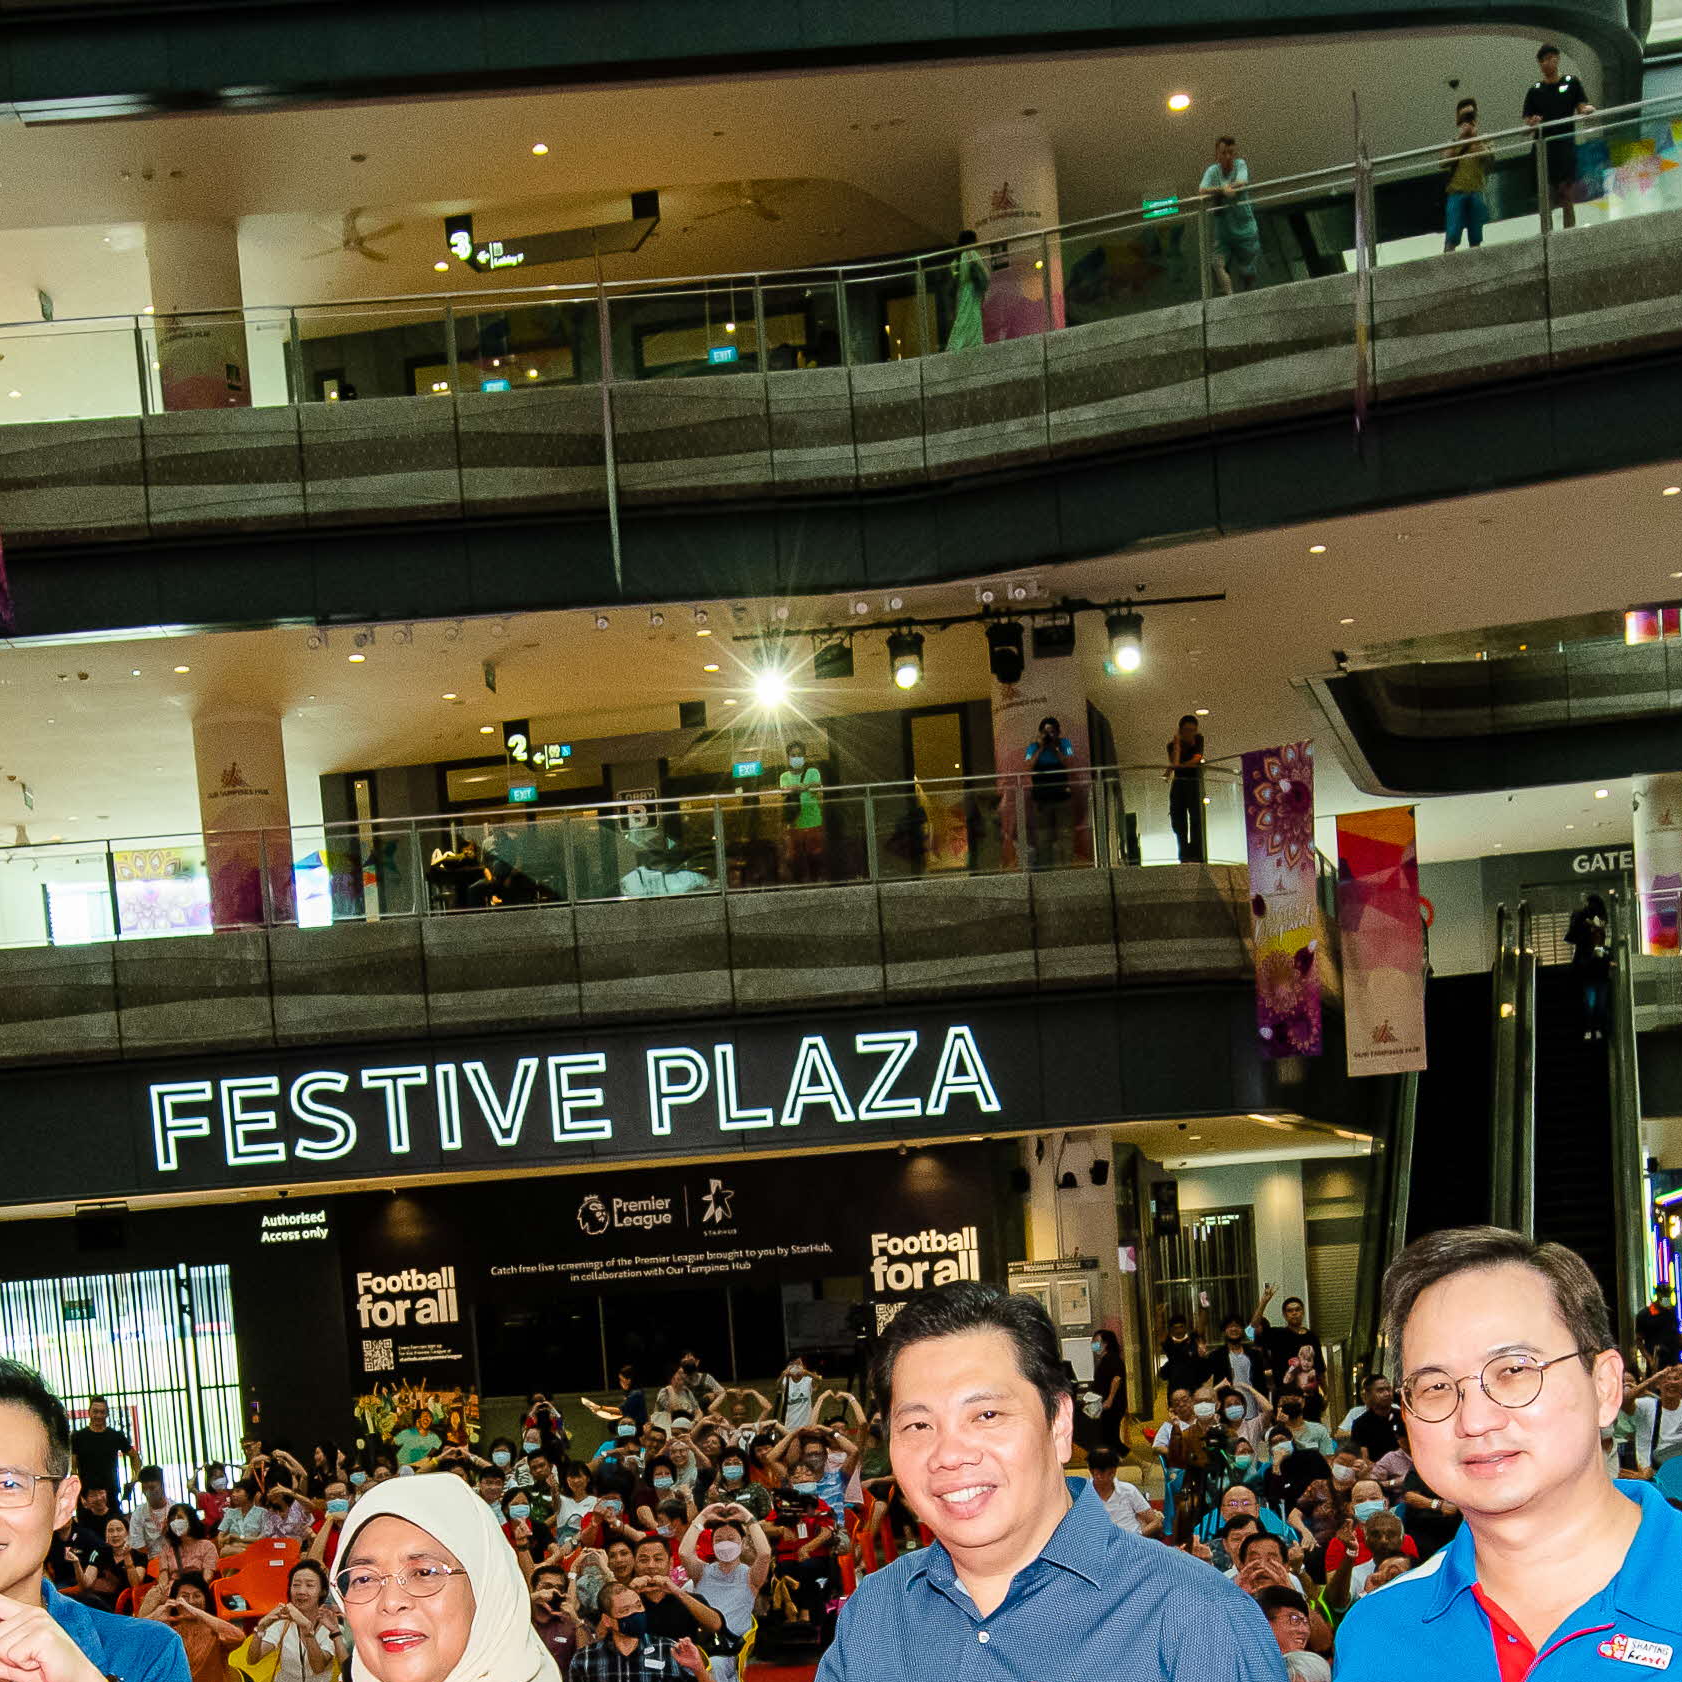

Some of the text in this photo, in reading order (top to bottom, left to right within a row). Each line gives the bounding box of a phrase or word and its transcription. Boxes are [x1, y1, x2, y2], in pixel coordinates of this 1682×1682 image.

[449, 230, 472, 261] 3
[507, 734, 528, 761] 2
[739, 763, 756, 776] EXIT
[512, 788, 533, 801] EXIT
[1573, 850, 1633, 875] GATE
[149, 1025, 1002, 1171] FESTIVE PLAZA
[613, 1195, 672, 1213] Premier
[261, 1210, 326, 1229] Authorised
[613, 1213, 672, 1230] League
[261, 1226, 329, 1244] Access only
[870, 1226, 979, 1257] Football
[491, 1242, 833, 1277] Catch free live screenings of the Premier League brought to you by StarHub,
[570, 1261, 752, 1283] in collaboration with Our Tampines Hub
[870, 1249, 981, 1292] for all
[355, 1266, 456, 1295] Football
[357, 1287, 459, 1329] for all
[1631, 1640, 1670, 1656] SHAPING
